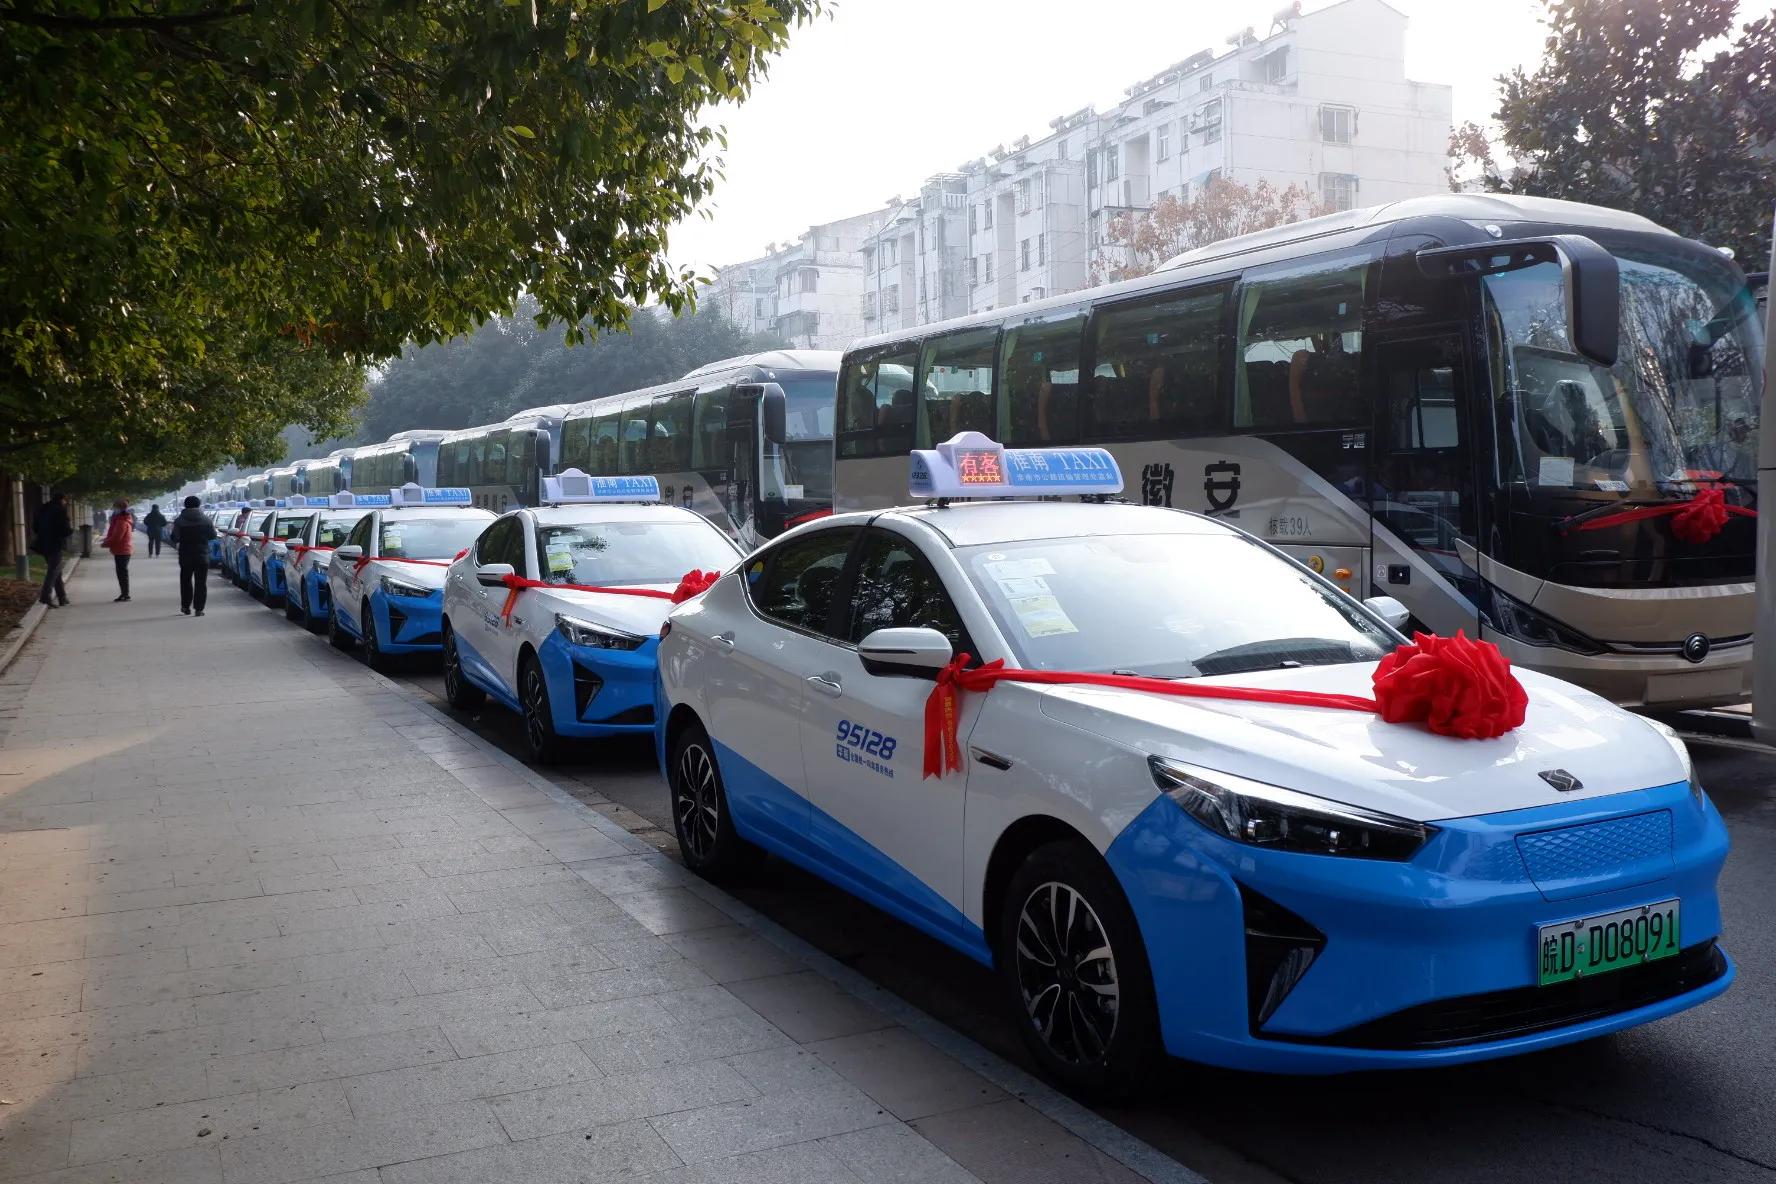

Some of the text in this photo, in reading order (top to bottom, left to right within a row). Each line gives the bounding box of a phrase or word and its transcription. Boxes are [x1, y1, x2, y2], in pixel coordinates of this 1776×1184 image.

[959, 452, 999, 474] 有客
[1007, 451, 1108, 471] 淮南 TAXI
[624, 478, 653, 488] TAXI
[837, 719, 897, 761] 95128
[1588, 909, 1674, 967] D08091
